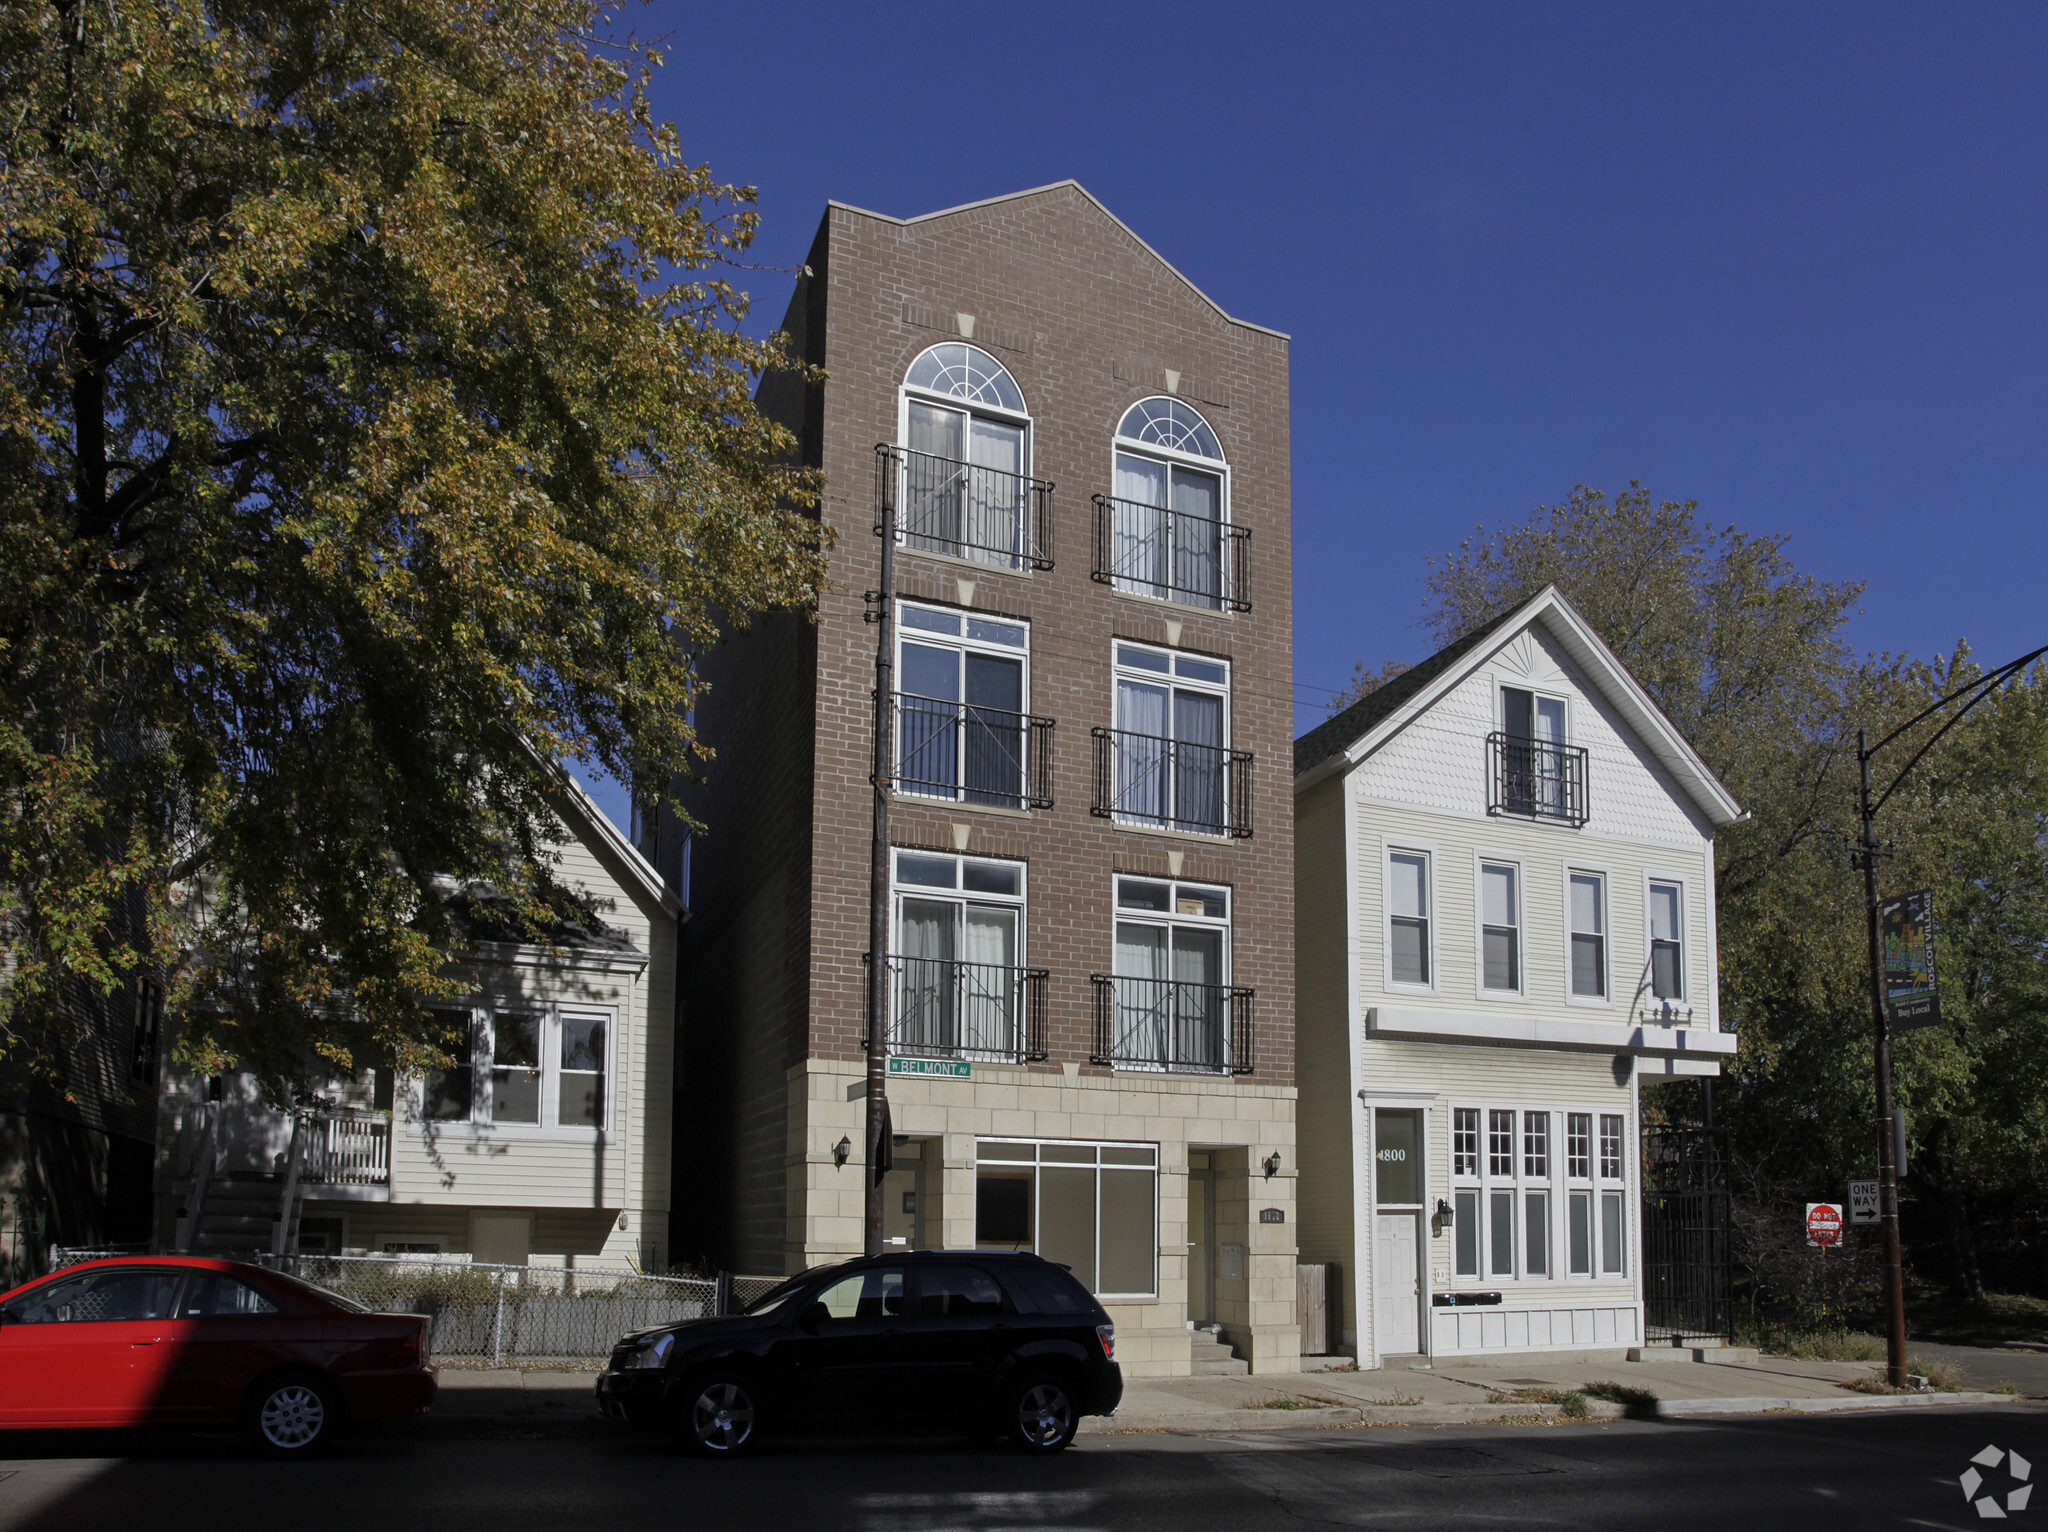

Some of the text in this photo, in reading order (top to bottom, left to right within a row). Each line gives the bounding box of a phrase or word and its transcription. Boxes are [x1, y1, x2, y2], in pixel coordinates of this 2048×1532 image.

[1923, 891, 1936, 990] ROSCOE VILLAGE
[1898, 1003, 1930, 1017] Buy Local
[892, 1060, 968, 1076] W BELMONT AV
[1853, 1184, 1877, 1195] ONE
[1853, 1196, 1877, 1206] WAY
[1812, 1212, 1821, 1220] DO
